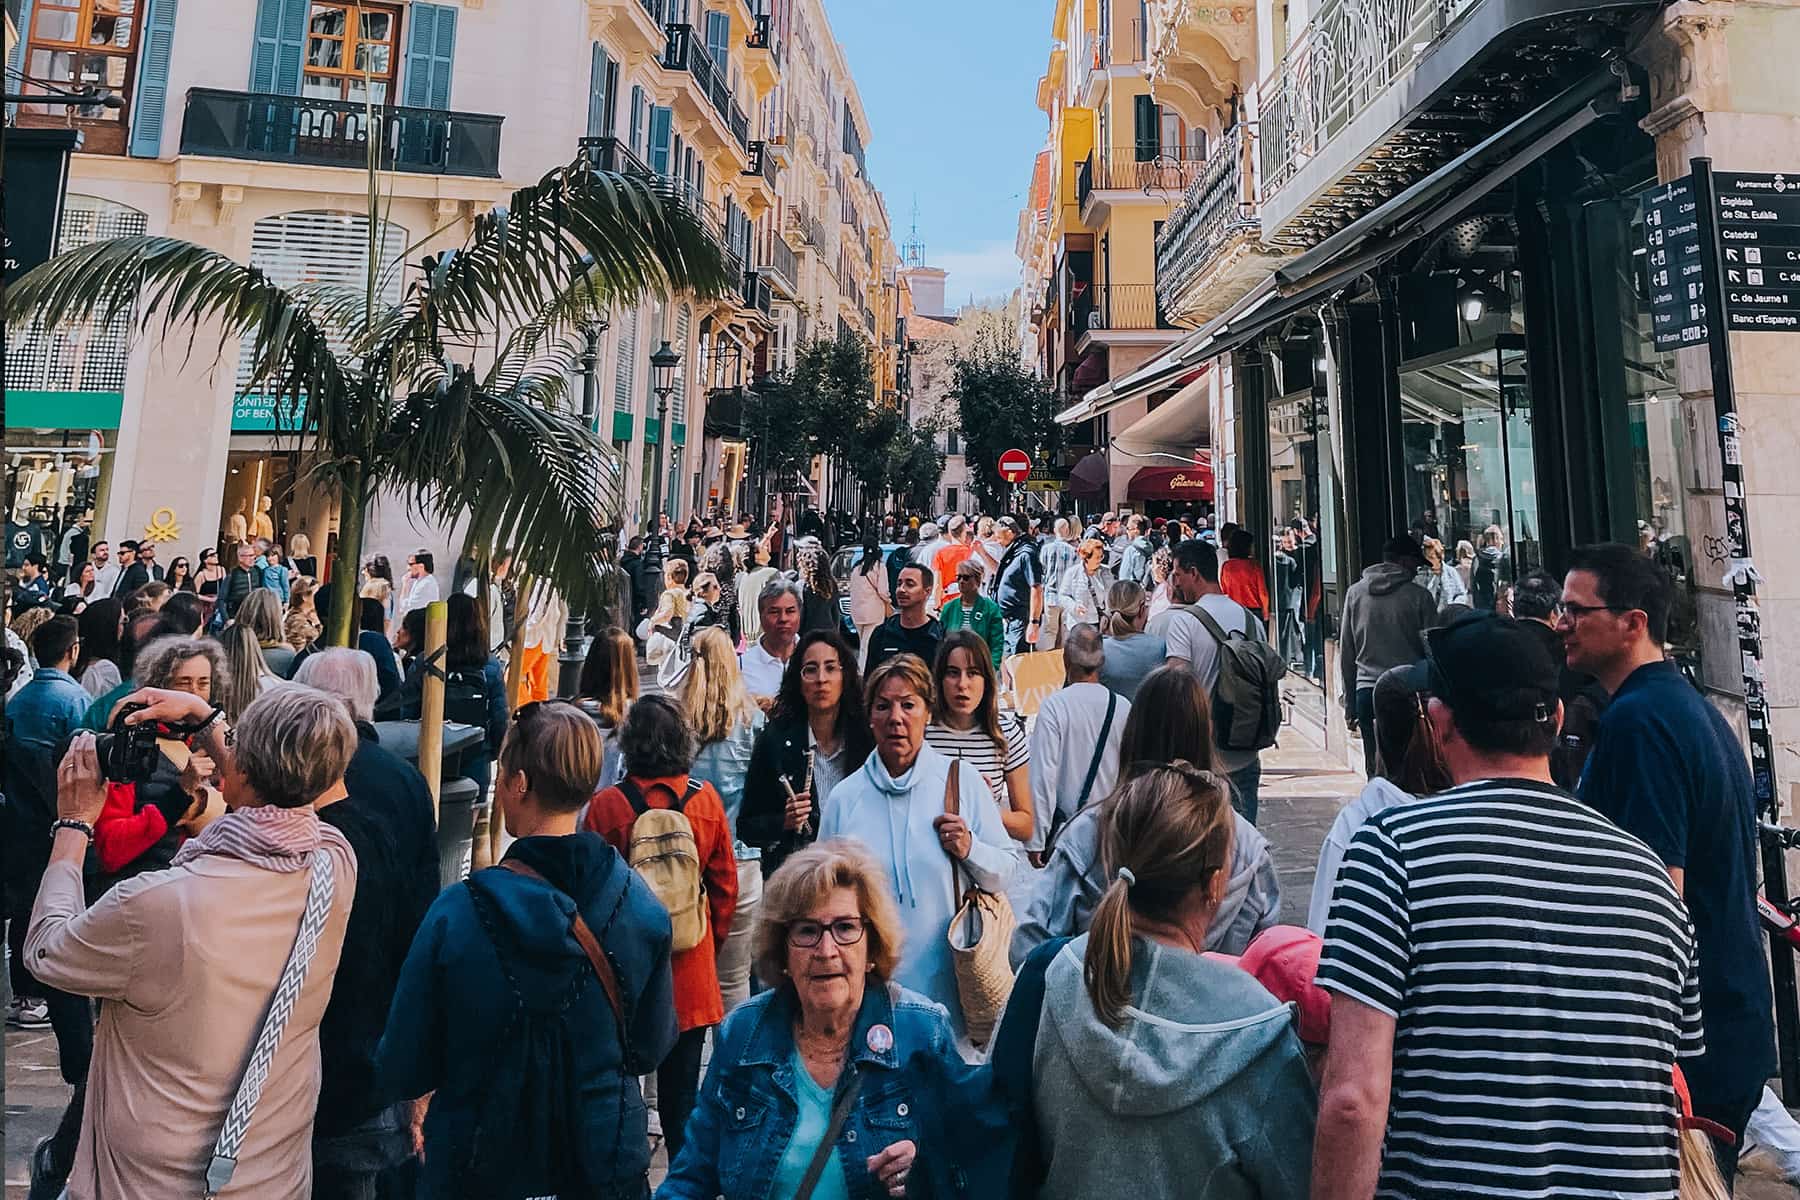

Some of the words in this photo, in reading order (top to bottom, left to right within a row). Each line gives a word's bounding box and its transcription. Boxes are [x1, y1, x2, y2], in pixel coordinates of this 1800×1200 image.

[1735, 180, 1773, 189] Ajuntament
[1722, 210, 1733, 219] de
[1722, 230, 1758, 240] Catedral
[1779, 272, 1789, 281] C.
[1730, 293, 1740, 302] C.
[1741, 294, 1753, 303] de
[1754, 294, 1781, 303] Jaume
[1732, 314, 1754, 324] Banc
[1755, 314, 1798, 326] d'Espanya
[237, 397, 277, 408] UNITED
[235, 409, 251, 418] OF
